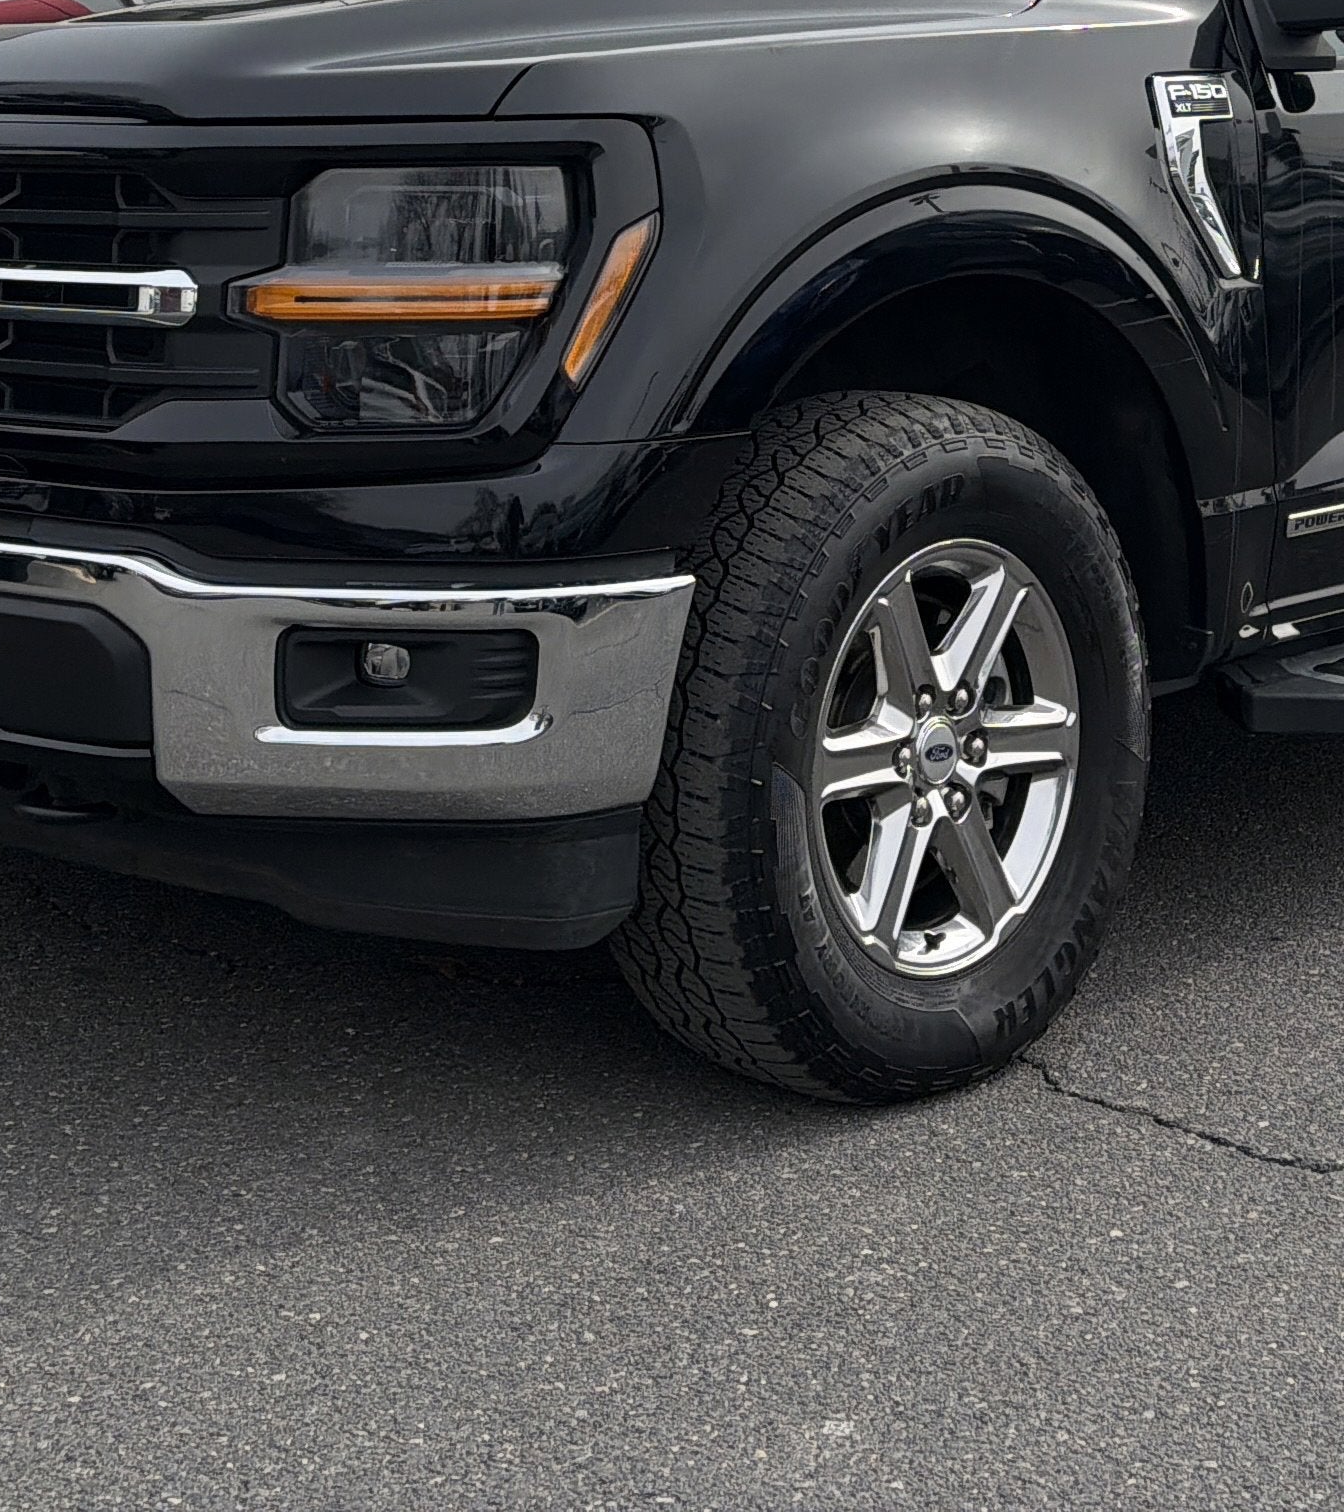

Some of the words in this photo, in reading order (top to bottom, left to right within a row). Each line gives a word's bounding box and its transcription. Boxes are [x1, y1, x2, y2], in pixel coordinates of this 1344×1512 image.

[1167, 83, 1228, 101] F-150
[1174, 102, 1192, 113] XLT
[929, 746, 950, 760] Ford
